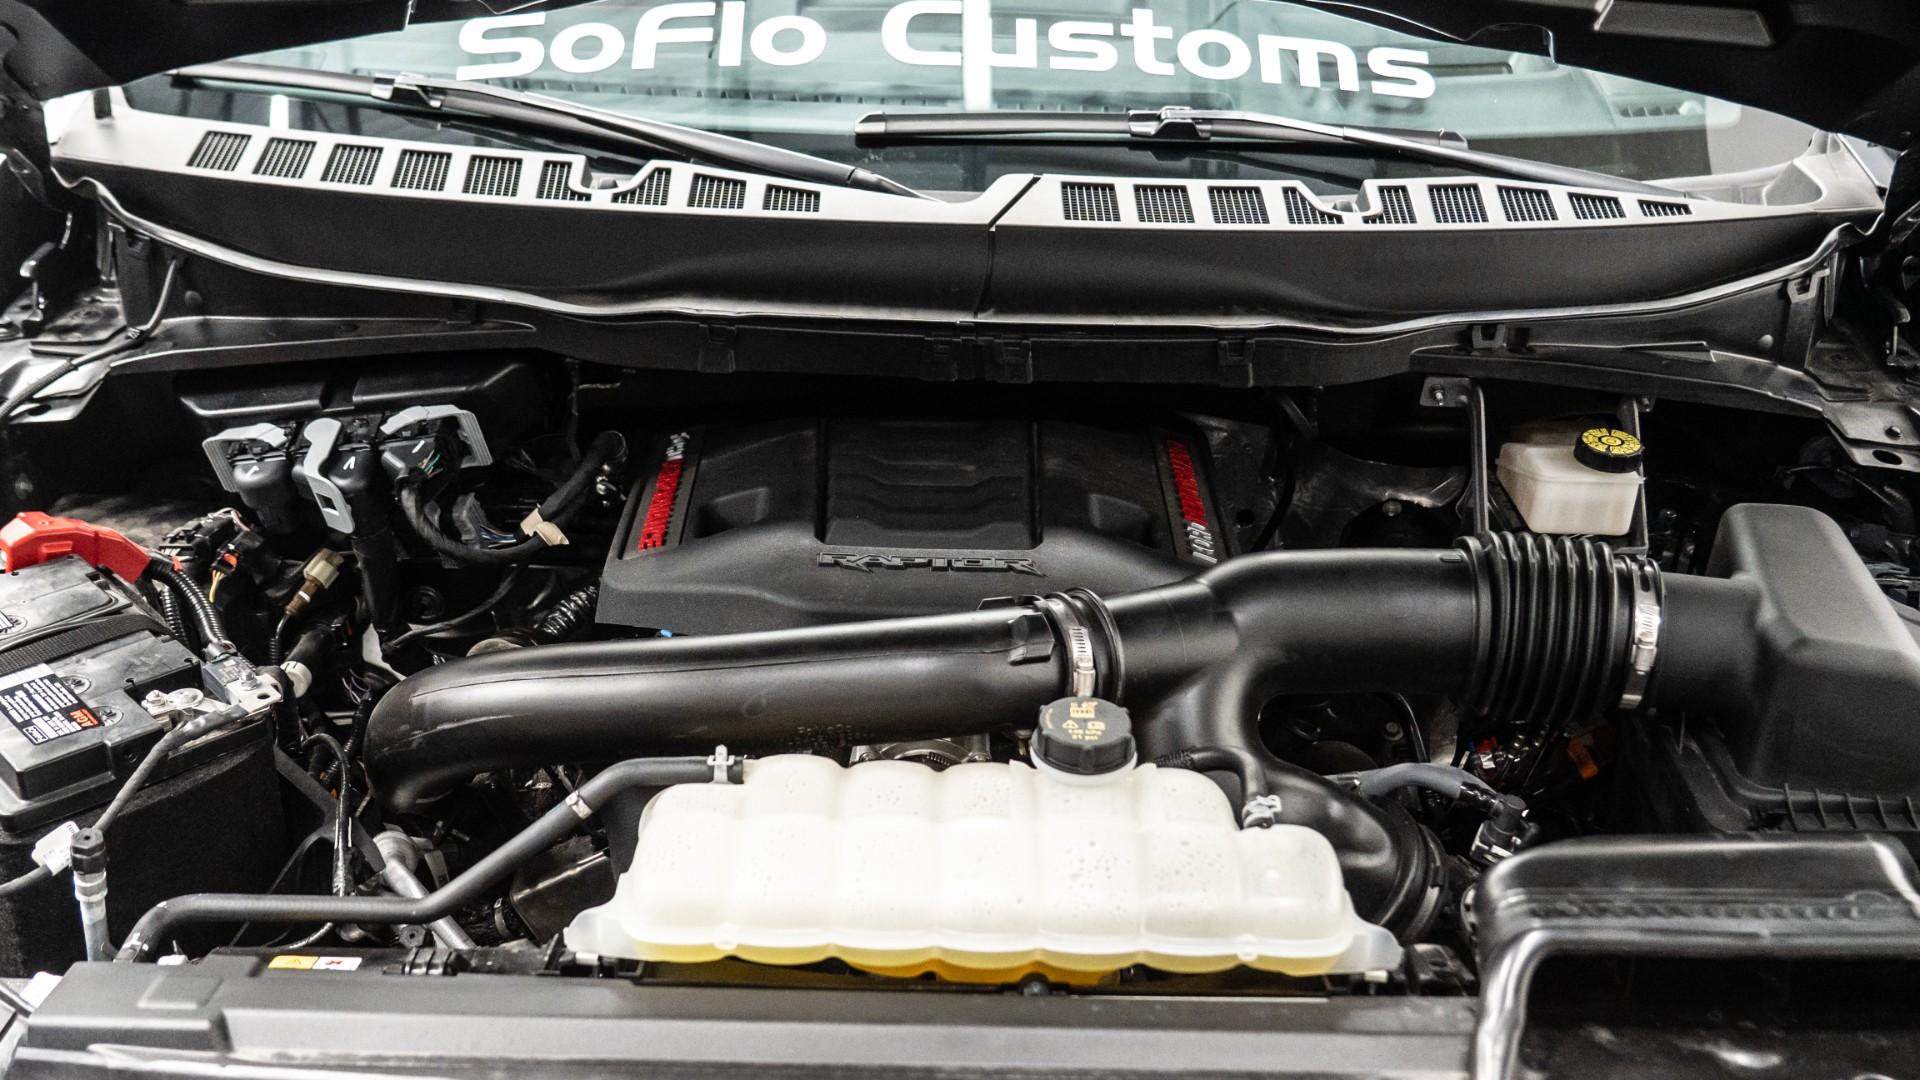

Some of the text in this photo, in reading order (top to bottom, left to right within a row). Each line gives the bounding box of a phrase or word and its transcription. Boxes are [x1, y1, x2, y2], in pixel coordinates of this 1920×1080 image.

[456, 0, 1436, 99] SoFlo Customs
[817, 552, 1047, 577] RAPTOR
[70, 710, 94, 727] AGM
